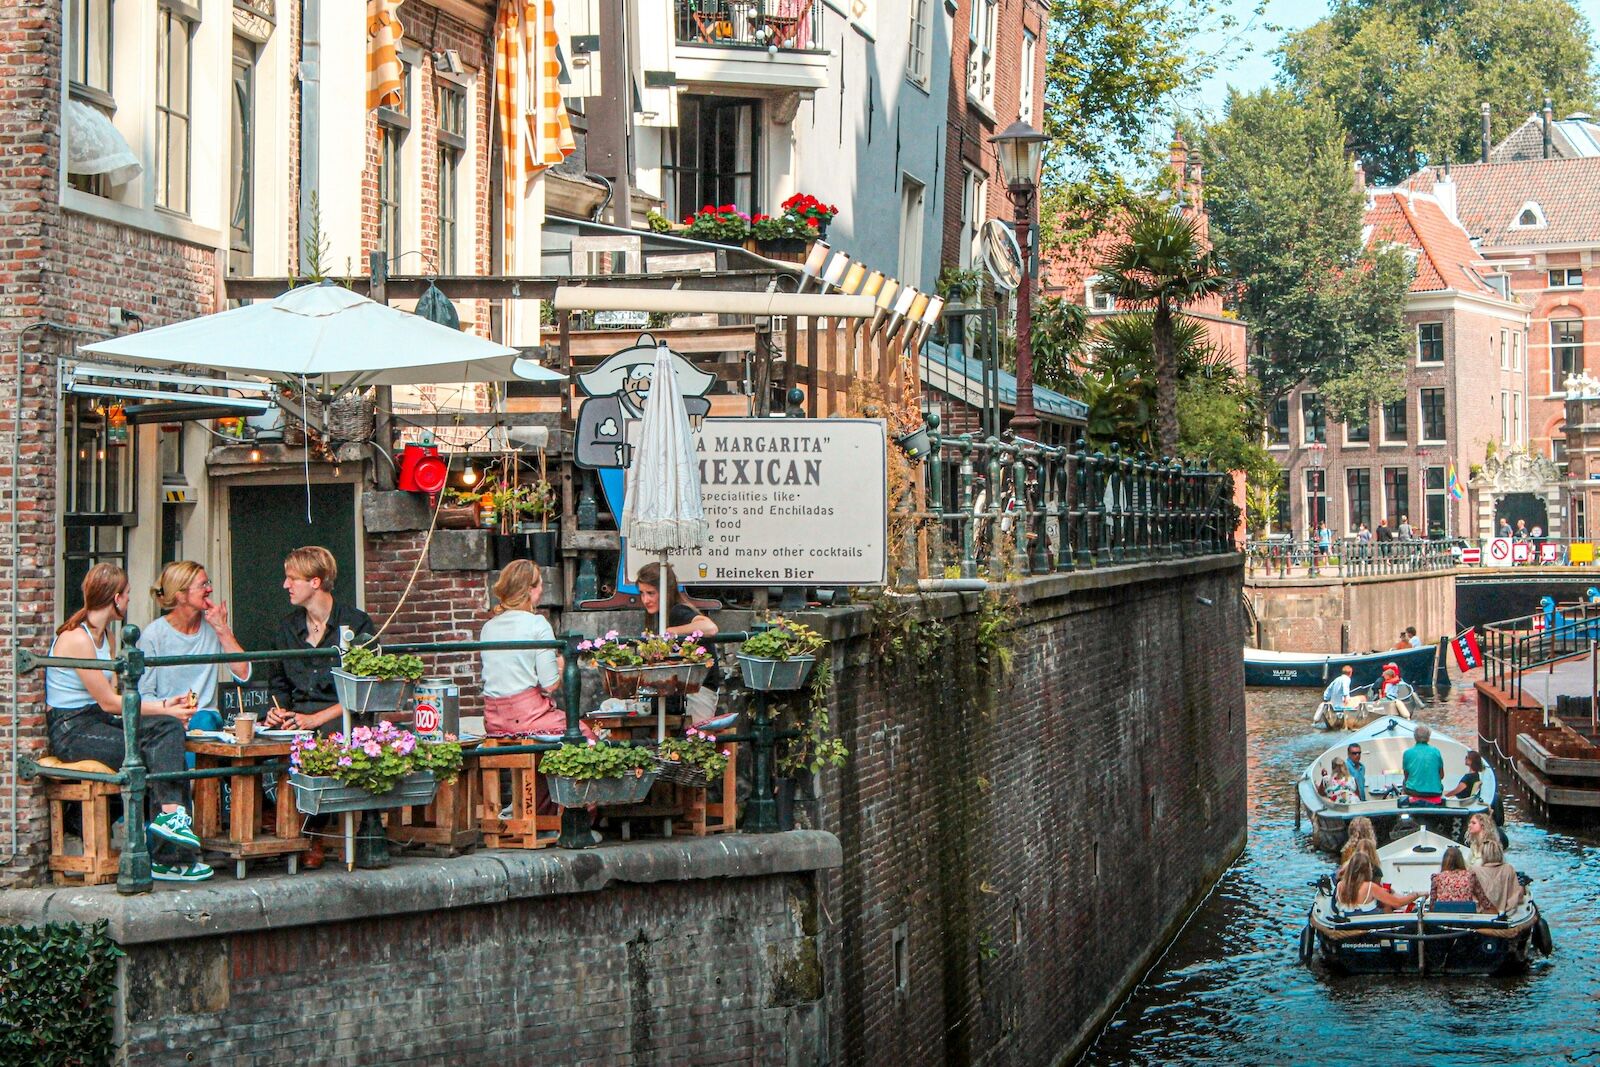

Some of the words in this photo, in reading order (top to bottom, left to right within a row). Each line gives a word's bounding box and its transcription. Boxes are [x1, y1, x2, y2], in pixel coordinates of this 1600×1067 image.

[696, 436, 706, 452] A
[702, 505, 738, 515] rrito's
[743, 505, 764, 515] and
[770, 505, 834, 516] Enchiladas
[716, 519, 741, 529] food
[720, 534, 741, 543] our
[708, 547, 729, 557] and
[735, 548, 767, 557] many
[772, 547, 804, 557] other
[809, 547, 863, 557] cocktails
[716, 567, 780, 578] Heineken
[784, 567, 815, 579] Bier
